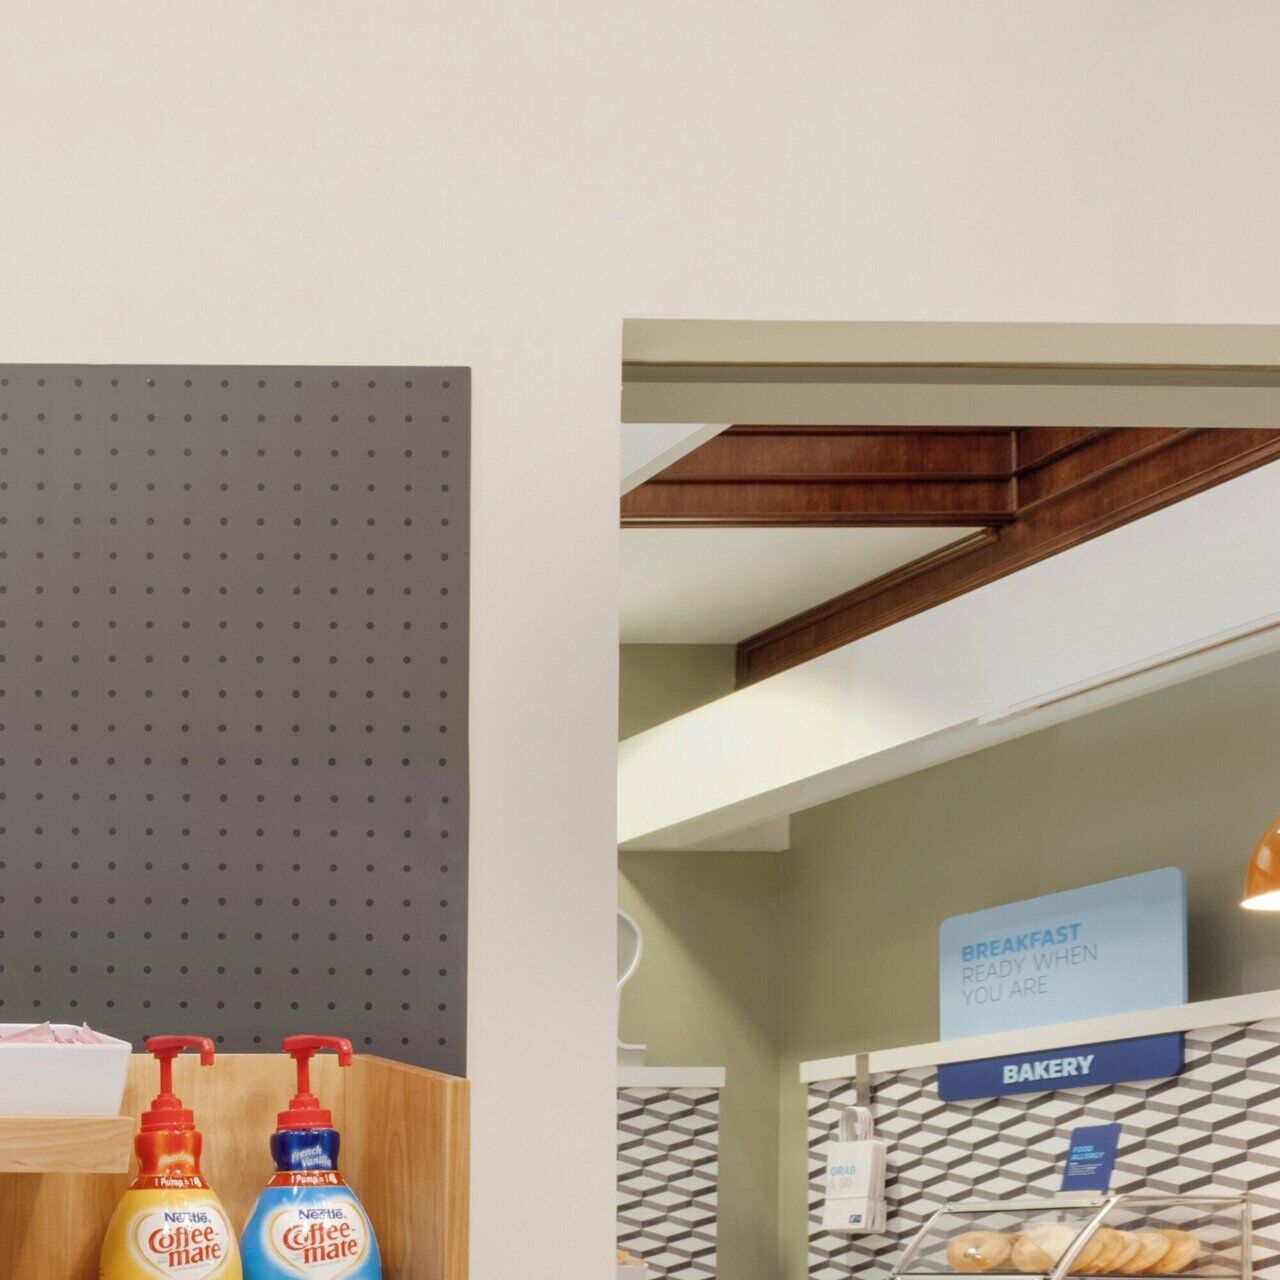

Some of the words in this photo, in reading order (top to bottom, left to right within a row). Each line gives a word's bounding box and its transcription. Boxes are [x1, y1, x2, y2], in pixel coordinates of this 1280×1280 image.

[961, 923, 1081, 963] BREAKFAST
[962, 956, 1026, 984] READY
[1032, 943, 1098, 971] WHEN
[961, 984, 1002, 1006] YOU
[1009, 975, 1048, 998] ARE
[1002, 1055, 1095, 1084] BAKERY
[292, 1145, 322, 1162] French
[301, 1153, 332, 1168] Vanilla
[168, 1243, 222, 1268] mate
[303, 1239, 358, 1264] mate
